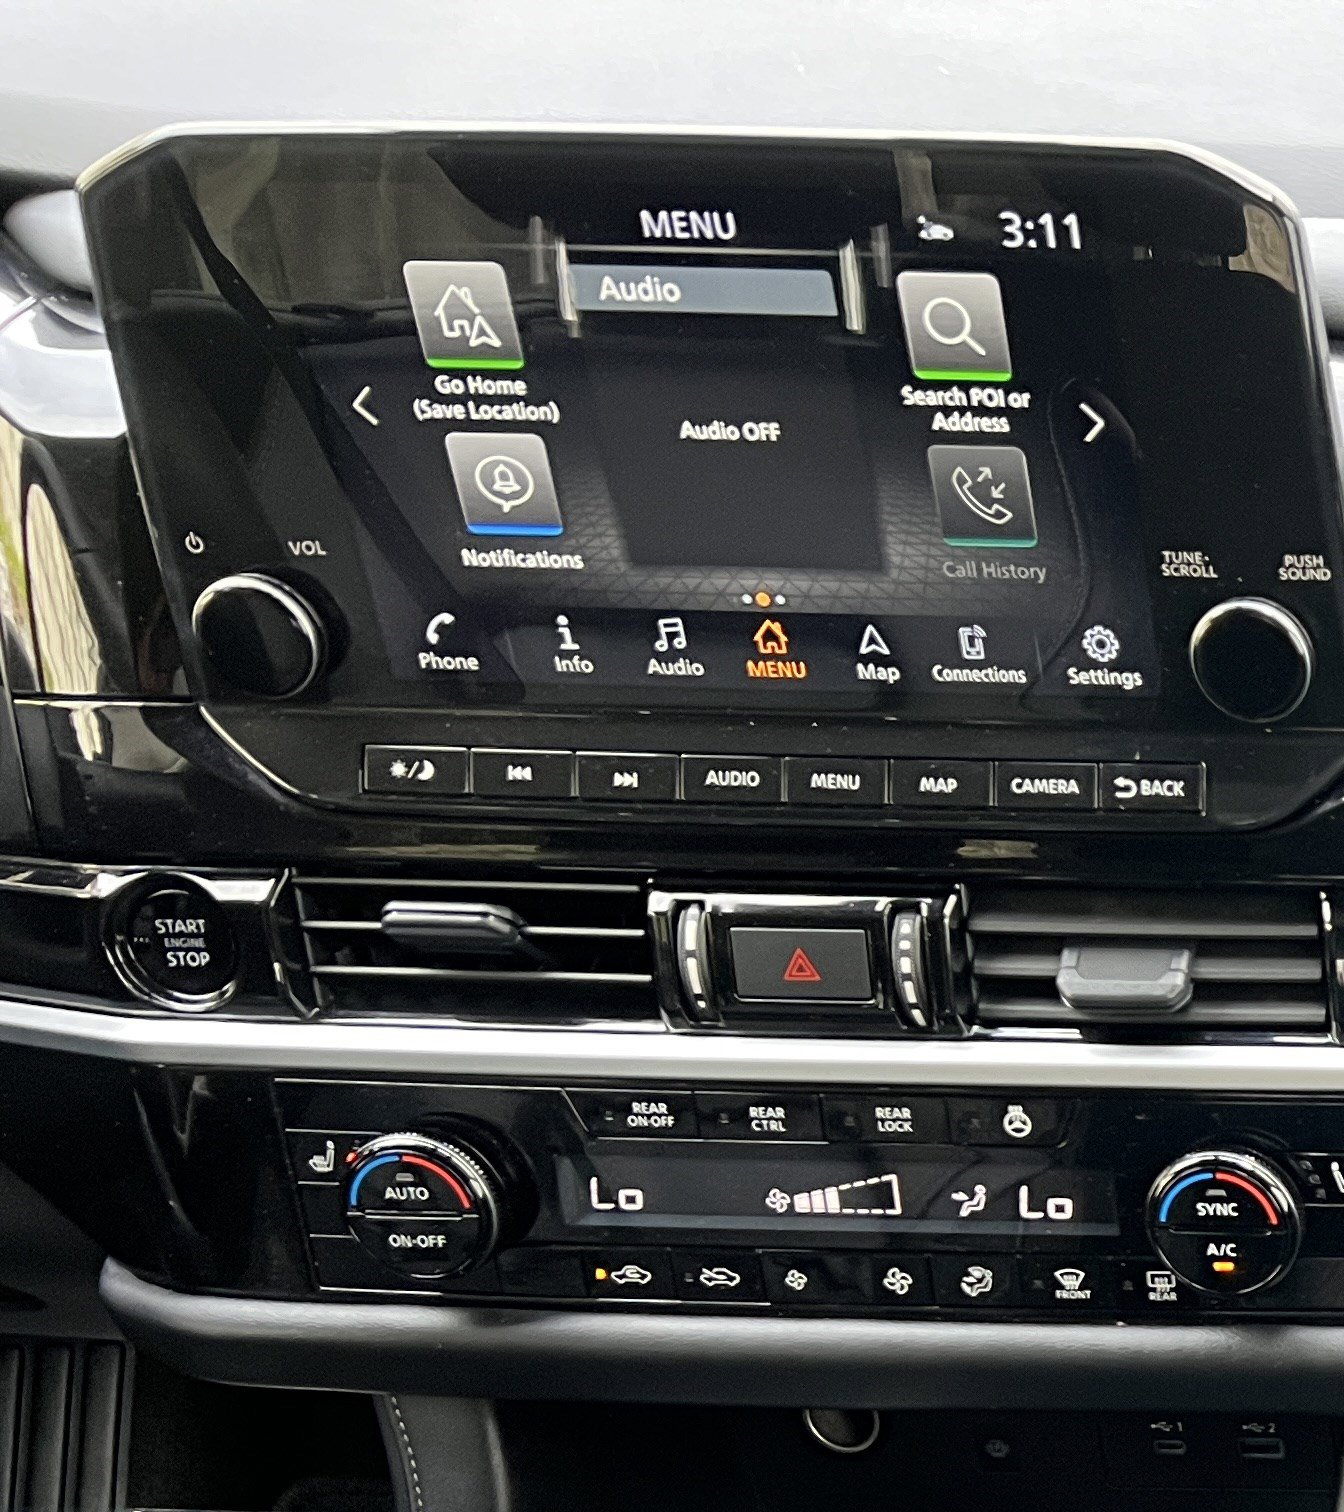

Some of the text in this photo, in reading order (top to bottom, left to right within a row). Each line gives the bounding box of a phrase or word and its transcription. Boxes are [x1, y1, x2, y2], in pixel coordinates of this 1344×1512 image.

[639, 210, 737, 240] MENU
[999, 211, 1082, 250] 3:11
[599, 275, 682, 303] Audio
[434, 376, 527, 396] Go Home
[902, 386, 1031, 409] Search POI or
[413, 399, 561, 424] (Save Location)
[680, 420, 781, 442] Audio OFF
[932, 412, 1010, 433] Address
[288, 540, 327, 556] VOL
[461, 548, 584, 570] Notifications
[1284, 554, 1325, 568] PUSH
[942, 561, 1047, 585] Call History
[1161, 564, 1218, 579] SCROLL
[1278, 567, 1332, 582] SOUND
[418, 653, 480, 673] Phone
[554, 654, 594, 674] Info
[647, 657, 705, 678] Audio
[747, 660, 807, 681] MENU
[857, 662, 901, 686] Map
[931, 664, 1027, 685] Connections
[1067, 665, 1143, 691] Settings
[704, 769, 761, 789] AUDIO
[810, 773, 861, 793] MENU
[920, 775, 958, 795] MAP
[1010, 776, 1080, 797] CAMERA
[1140, 777, 1186, 799] BACK
[154, 918, 206, 935] START
[163, 937, 206, 949] ENGINE
[166, 951, 211, 968] STOP
[631, 1101, 668, 1116] REAR
[748, 1106, 786, 1120] REAR
[874, 1107, 912, 1121] REAR
[750, 1118, 787, 1133] CTRL
[877, 1119, 914, 1134] LOCK
[384, 1186, 430, 1201] AUTO
[590, 1176, 644, 1211] Lo
[1018, 1185, 1074, 1220] Lo
[1196, 1202, 1239, 1219] SYNC
[1206, 1243, 1238, 1259] A/C
[1055, 1286, 1092, 1300] FRONT
[1148, 1289, 1178, 1302] REAR
